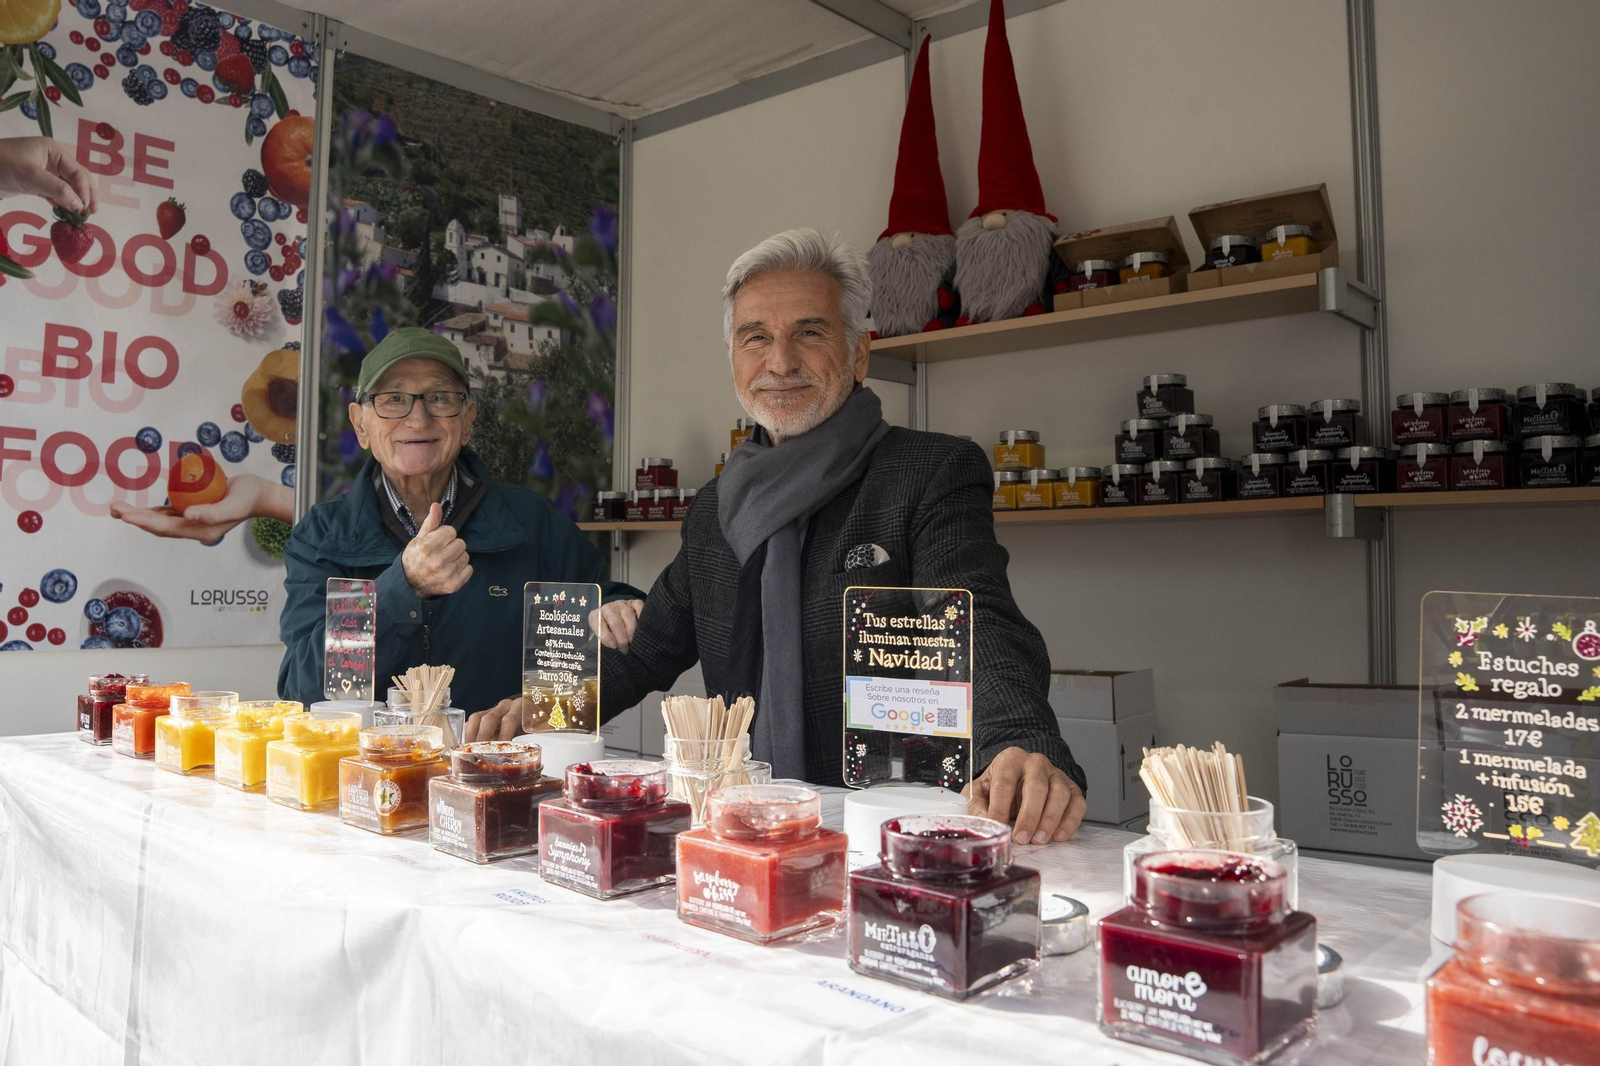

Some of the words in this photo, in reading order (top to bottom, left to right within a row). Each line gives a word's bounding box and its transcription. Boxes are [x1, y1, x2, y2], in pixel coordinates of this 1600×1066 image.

[76, 118, 176, 190] BE
[0, 210, 229, 297] GOOD
[41, 322, 180, 390] BIO
[0, 426, 215, 493] FOOD
[191, 589, 269, 606] LORUSSO
[539, 610, 581, 624] Ecológicas
[863, 612, 887, 628] Tus
[890, 614, 946, 630] estrellas
[536, 624, 585, 637] Artesanales
[858, 630, 911, 646] iluminan
[912, 636, 956, 648] nuestra
[561, 651, 586, 662] reducido
[868, 647, 944, 671] Navidad
[1476, 651, 1580, 678] Estuches
[538, 670, 559, 682] Tarro
[553, 683, 564, 696] 7€
[865, 683, 893, 693] Escribe
[912, 686, 940, 696] reseña
[867, 693, 890, 702] Sobre
[891, 695, 927, 705] nosotros
[1490, 677, 1563, 700] regalo
[871, 702, 936, 727] Google
[1454, 703, 1470, 720] 2
[1470, 705, 1600, 733] mermeladas
[1503, 728, 1544, 748] 17€
[1458, 749, 1471, 764] 1
[1472, 751, 1588, 780] mermelada
[1505, 794, 1544, 816] 15€
[548, 844, 591, 872] Symphony
[693, 870, 740, 897] raspberry
[1126, 964, 1207, 998] amore
[1134, 981, 1197, 1012] mora
